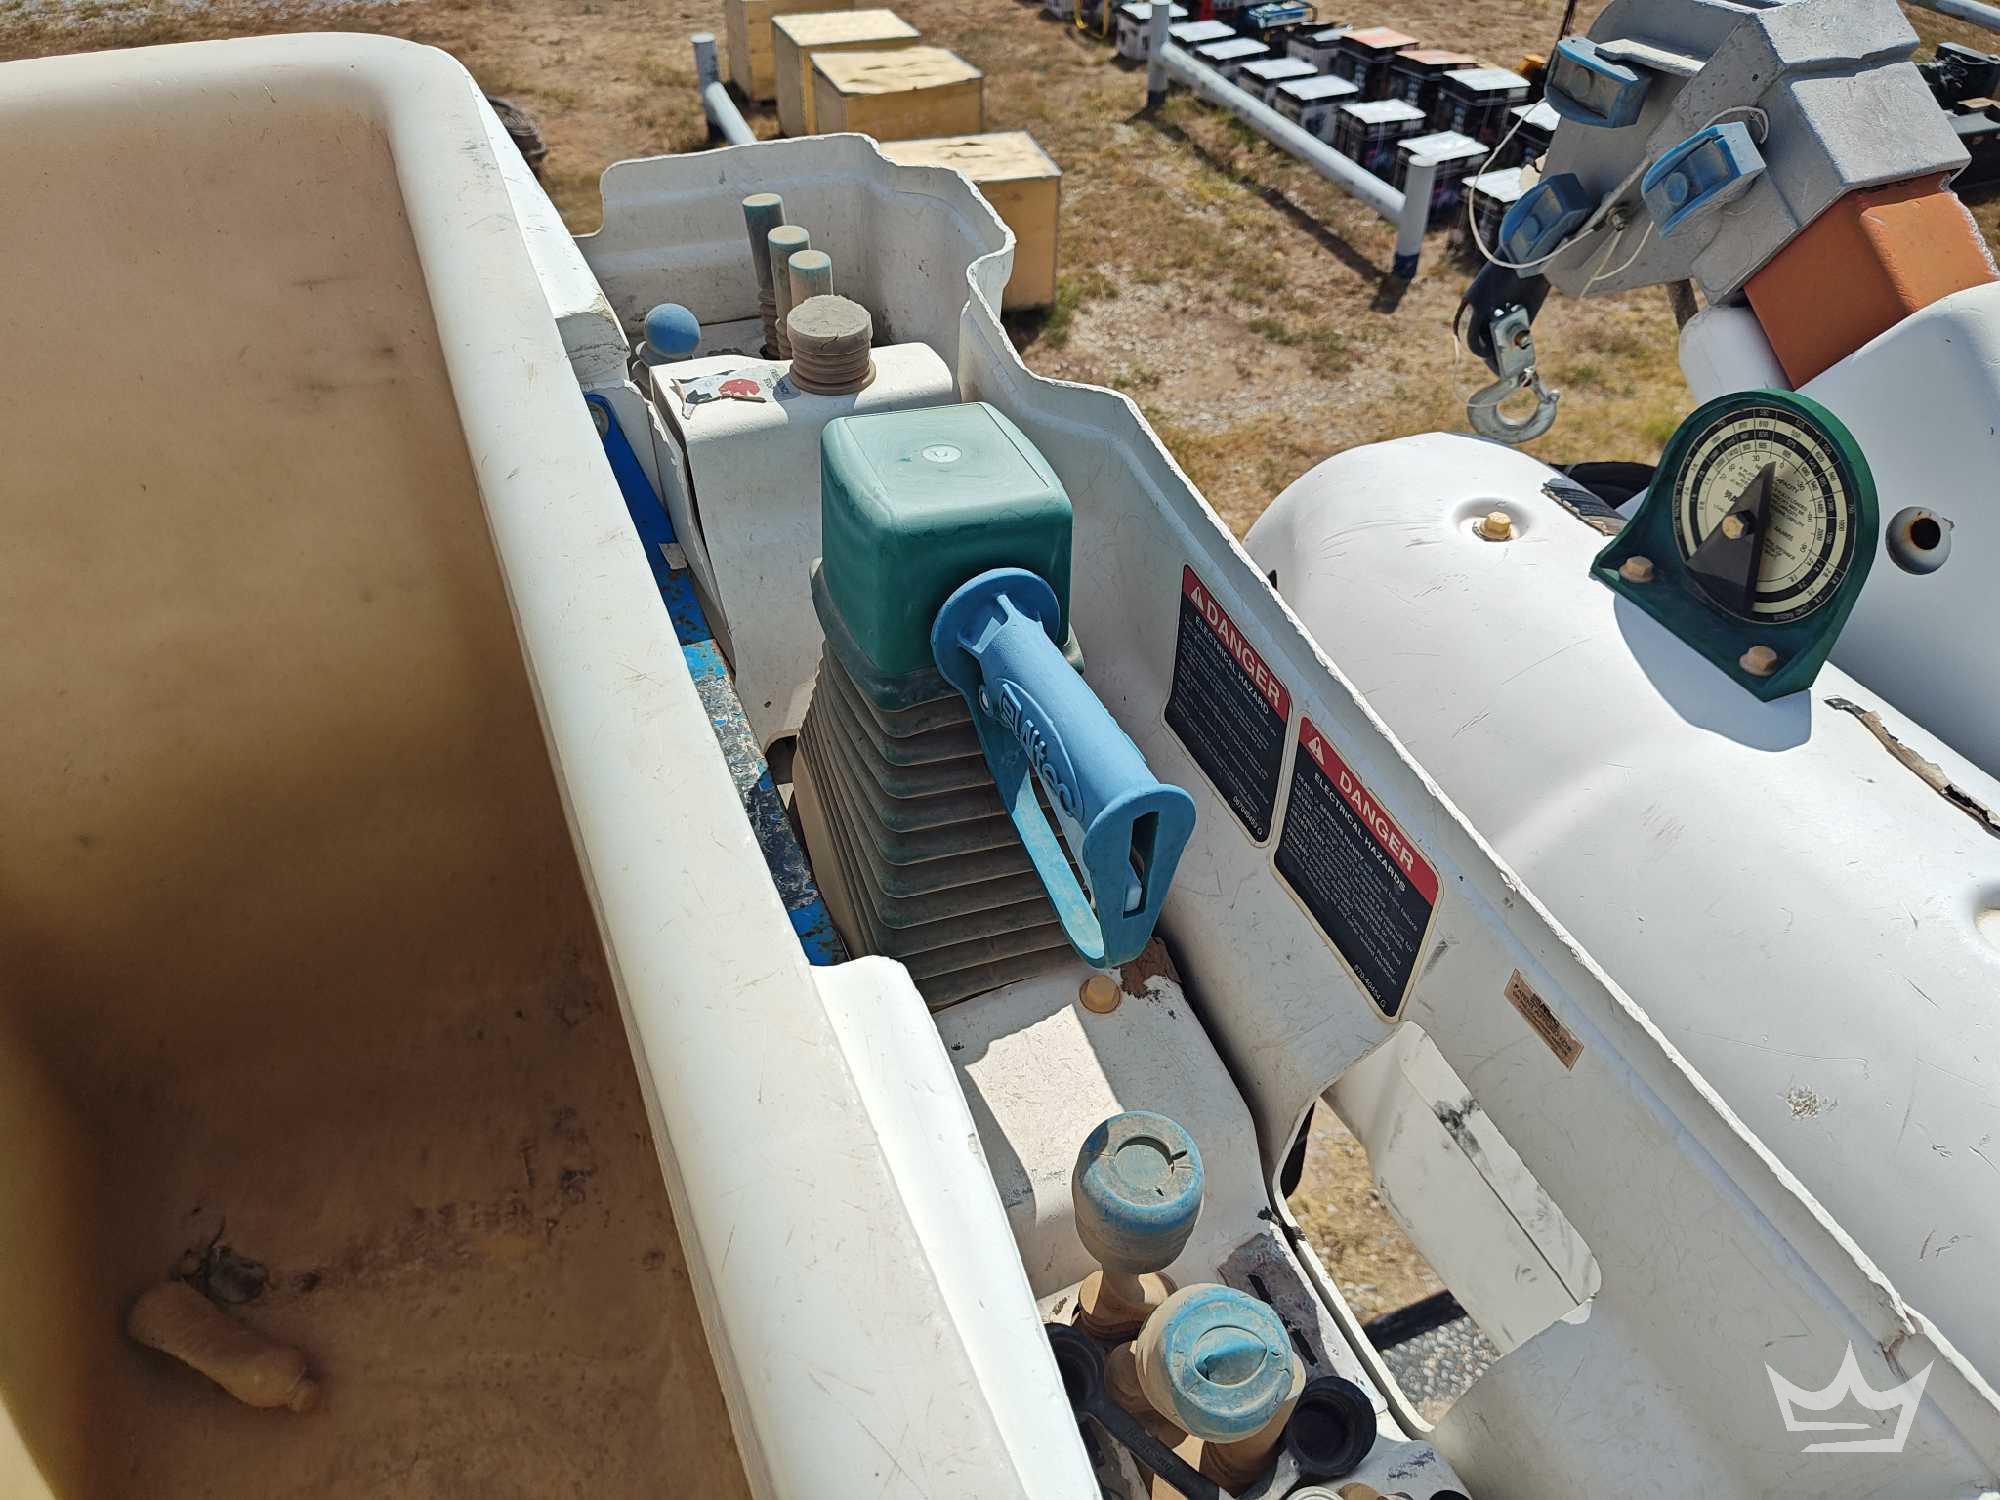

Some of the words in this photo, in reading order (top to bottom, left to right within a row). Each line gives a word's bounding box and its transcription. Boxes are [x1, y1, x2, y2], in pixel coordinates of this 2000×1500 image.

[1195, 614, 1237, 676] ELECTRICAL
[1237, 673, 1269, 716] HAZARD
[1207, 601, 1281, 703] DANGER
[1313, 770, 1364, 839] ELECTRICAL
[1364, 835, 1406, 893] HAZARDS
[1339, 770, 1414, 872] DANGER
